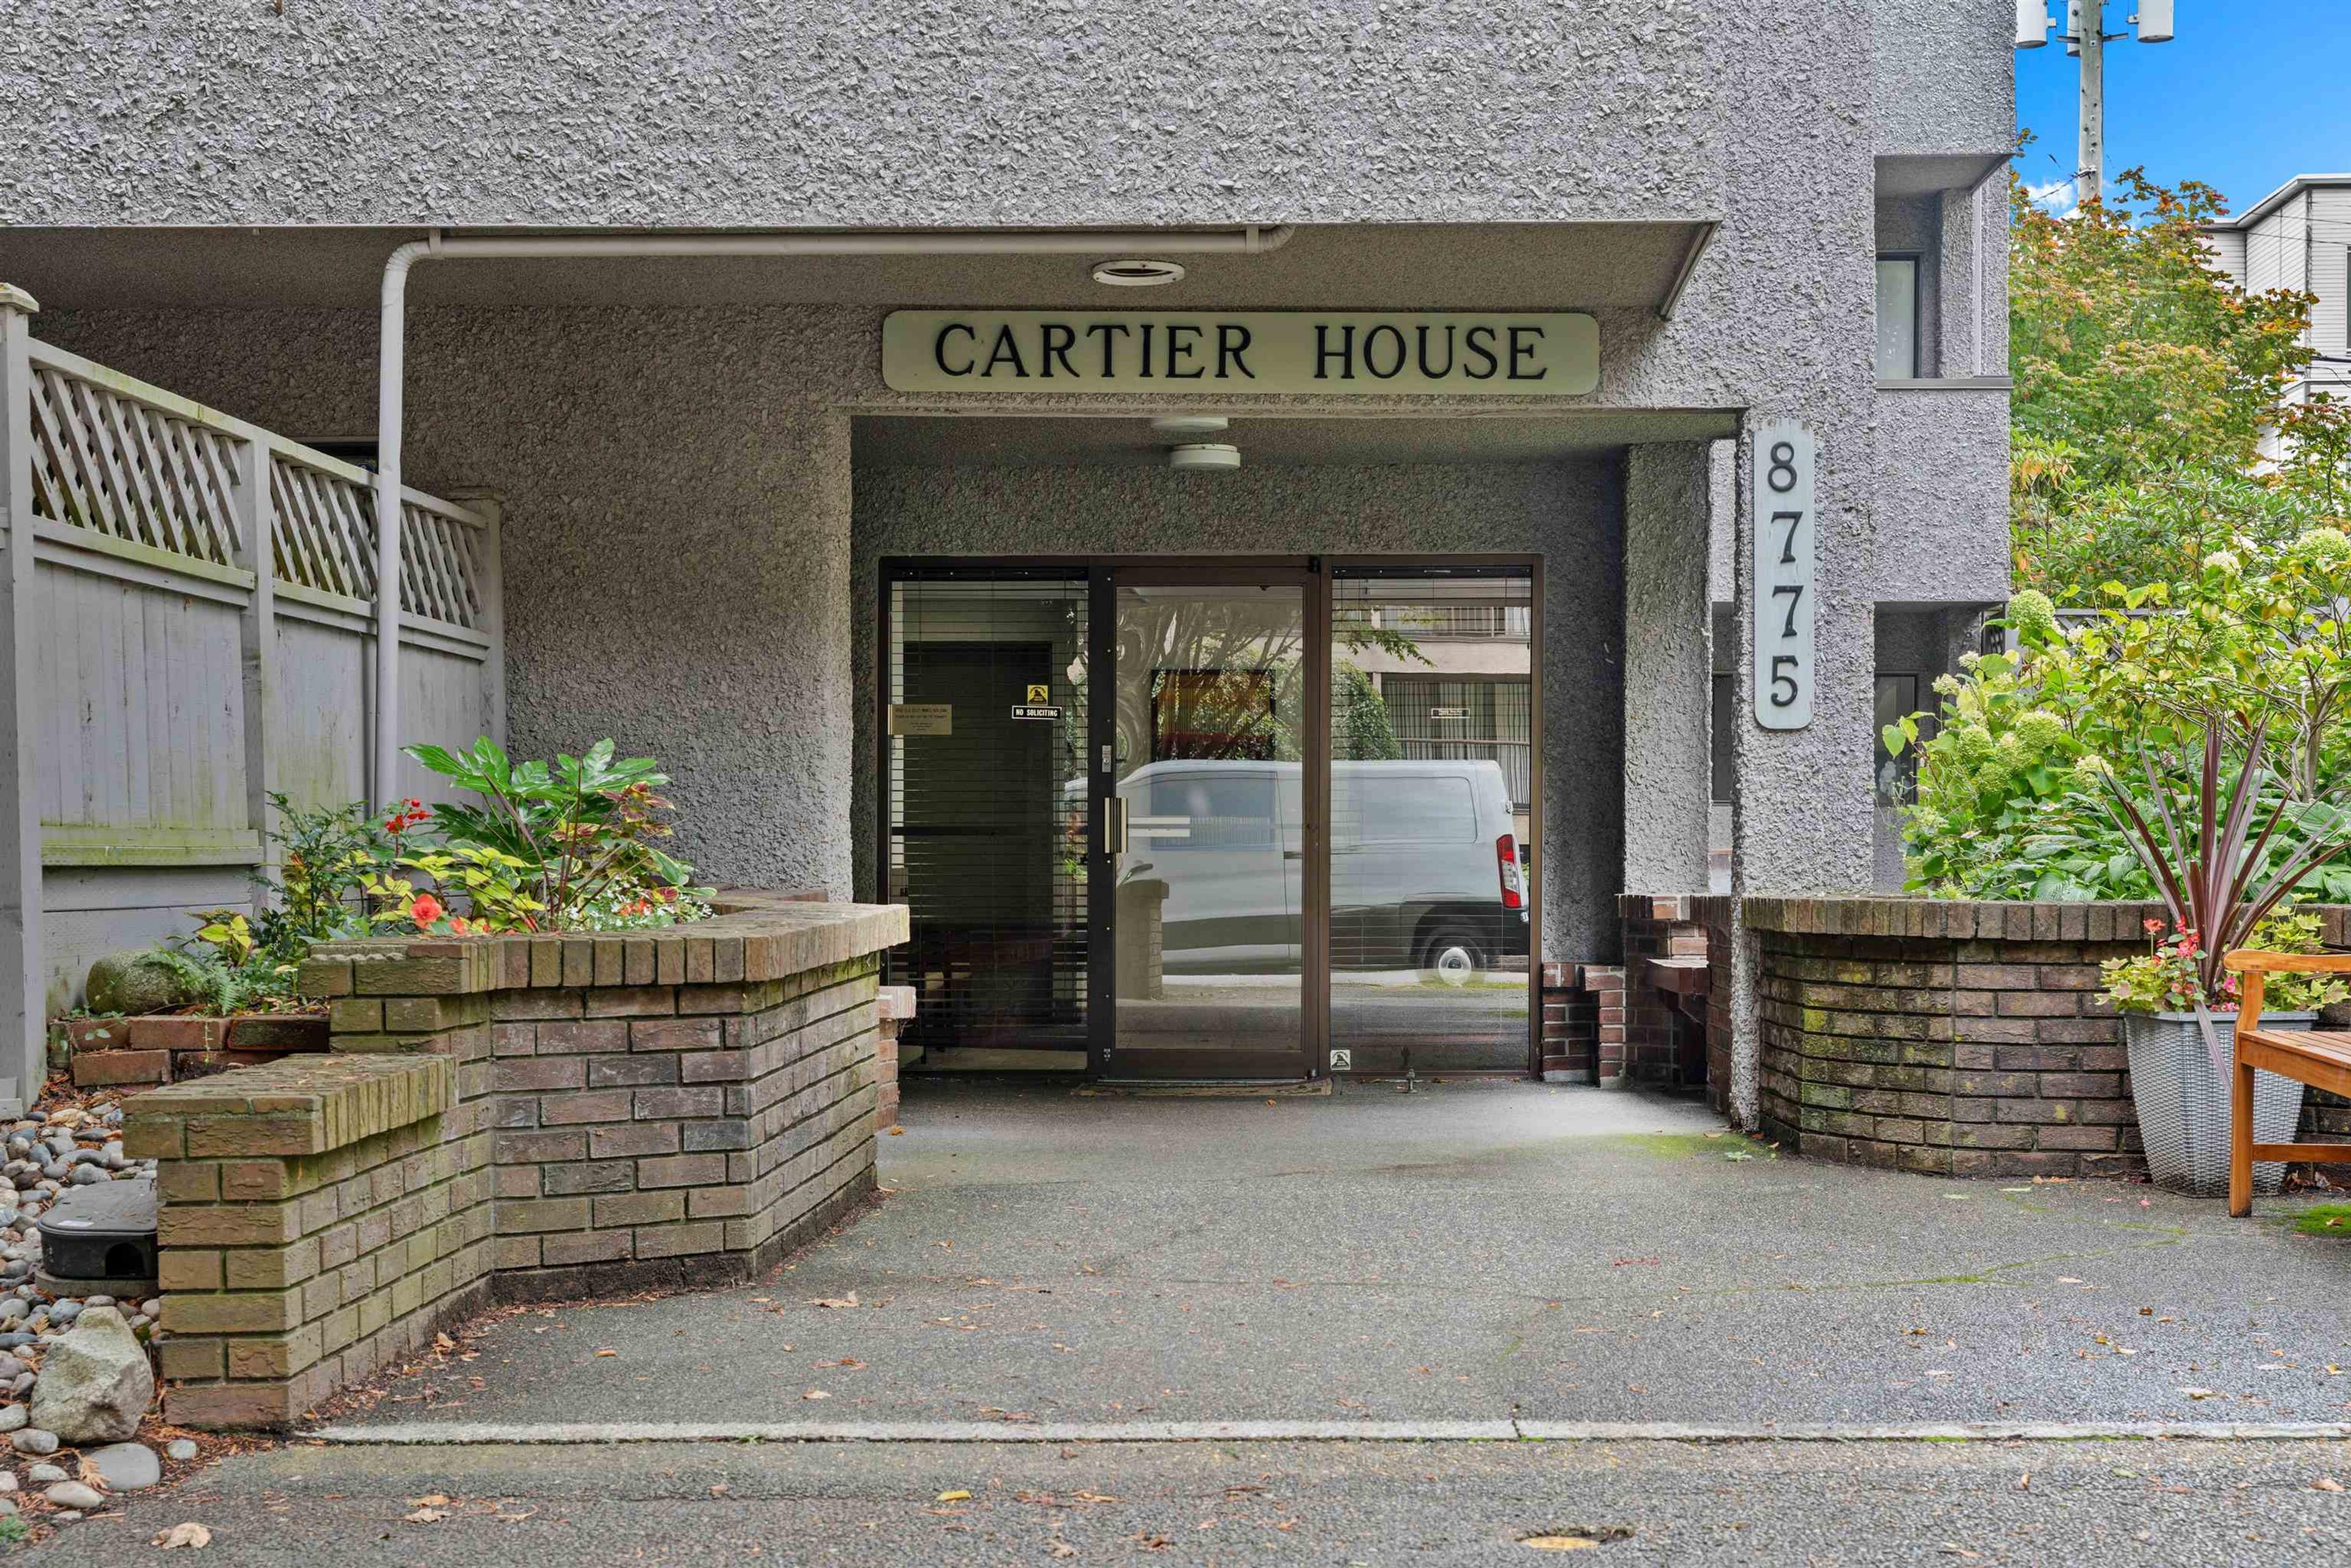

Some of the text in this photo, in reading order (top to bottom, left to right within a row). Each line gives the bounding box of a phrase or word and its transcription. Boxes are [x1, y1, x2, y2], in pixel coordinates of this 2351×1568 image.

[934, 323, 1548, 380] CARTIER HOUSE
[1768, 441, 1804, 707] 8775
